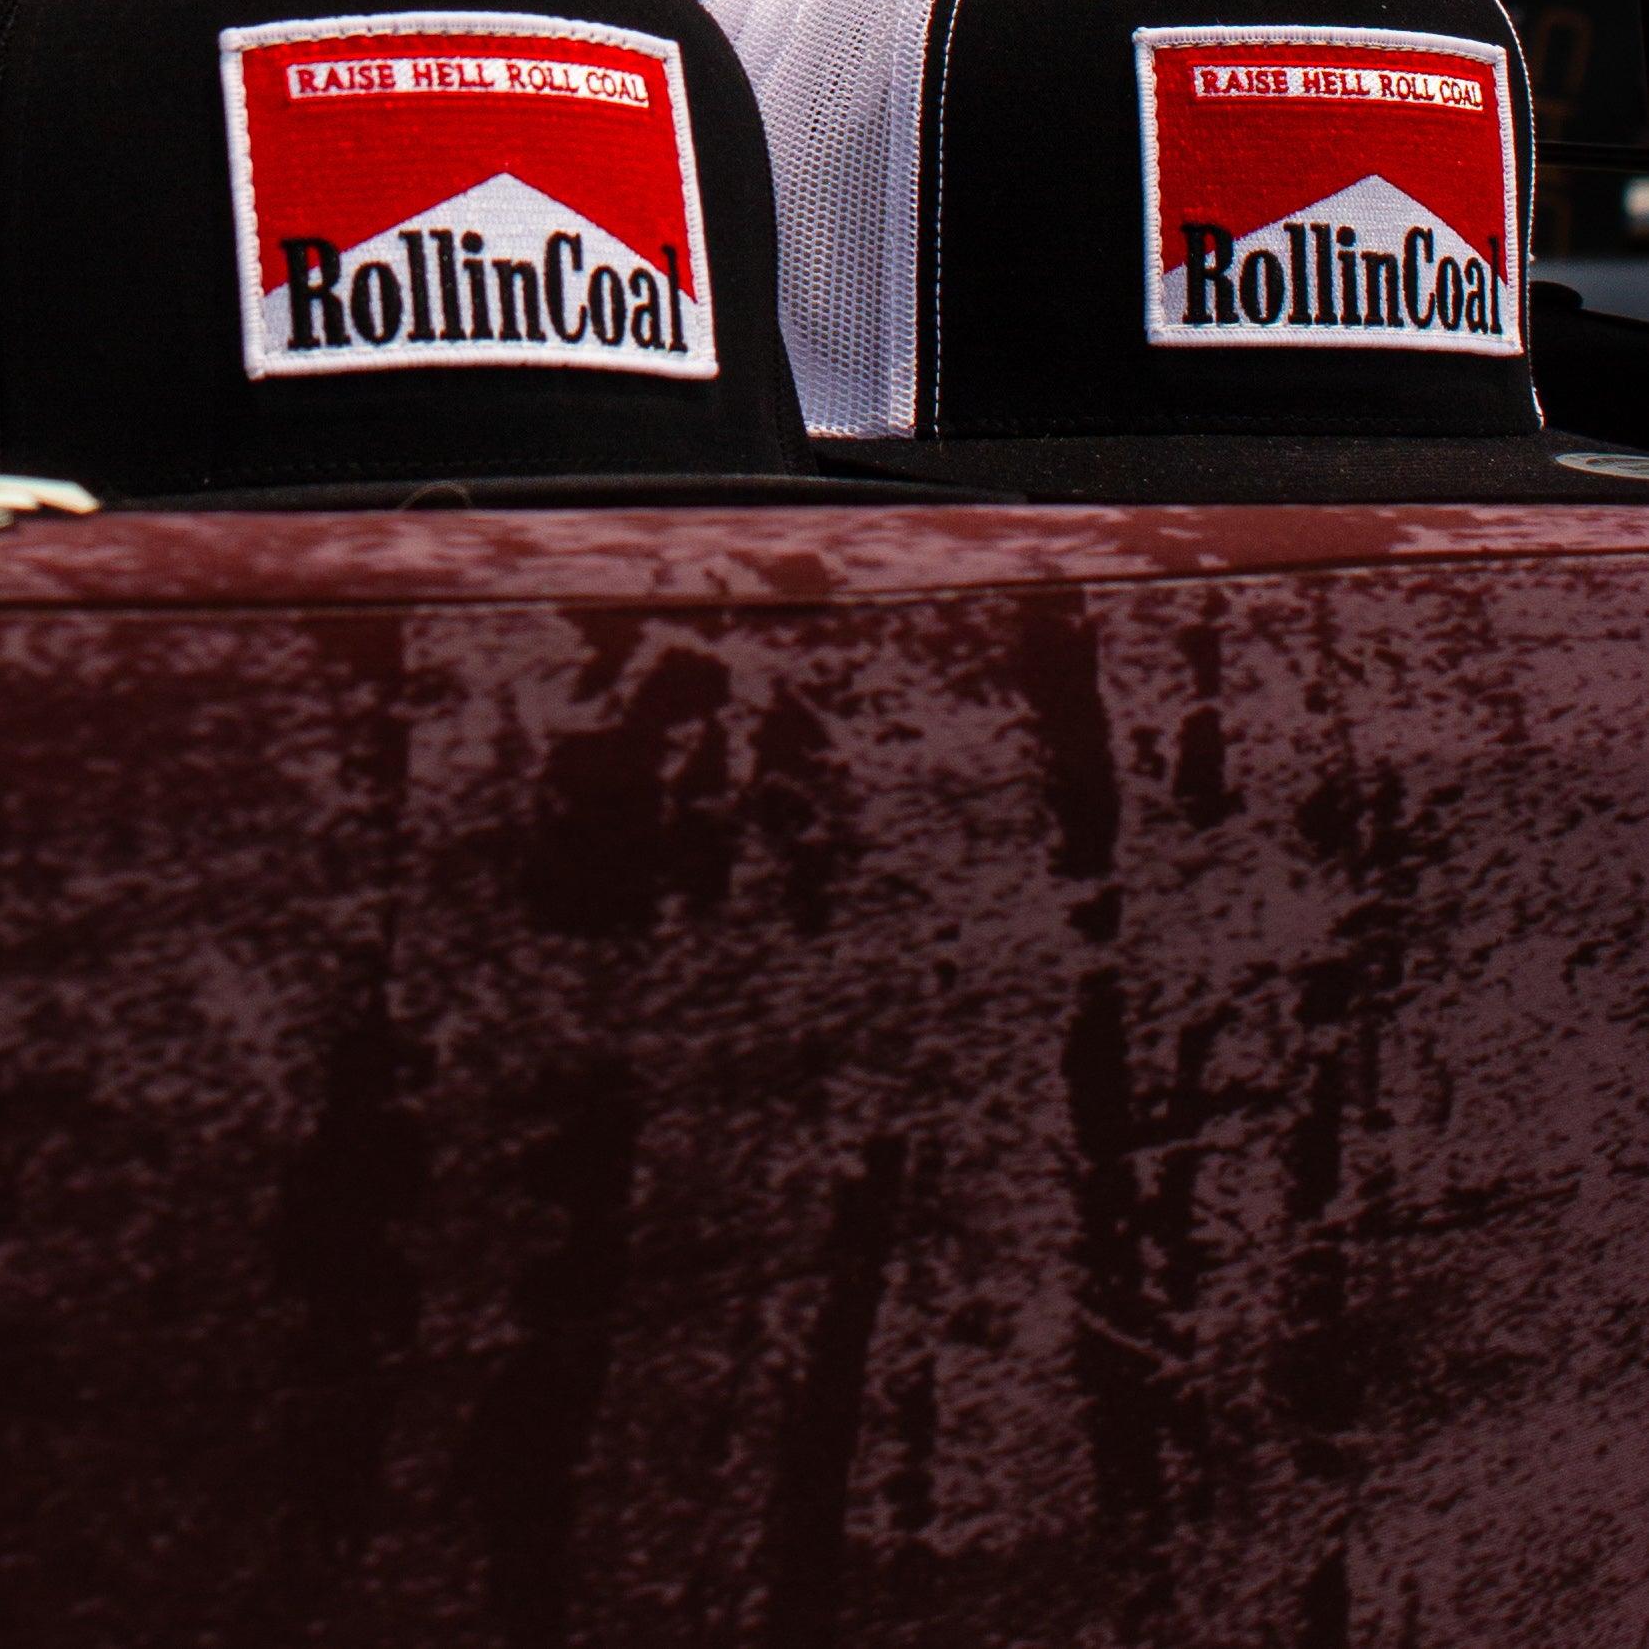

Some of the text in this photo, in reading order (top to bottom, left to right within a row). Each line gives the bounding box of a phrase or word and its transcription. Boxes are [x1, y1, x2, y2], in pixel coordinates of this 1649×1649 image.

[296, 62, 649, 103] RAISE HELL ROLL COAL
[1200, 69, 1484, 108] RAISE HELL ROLL COAL
[281, 229, 689, 353] RollinCoal
[1182, 222, 1504, 336] RollinCoal
